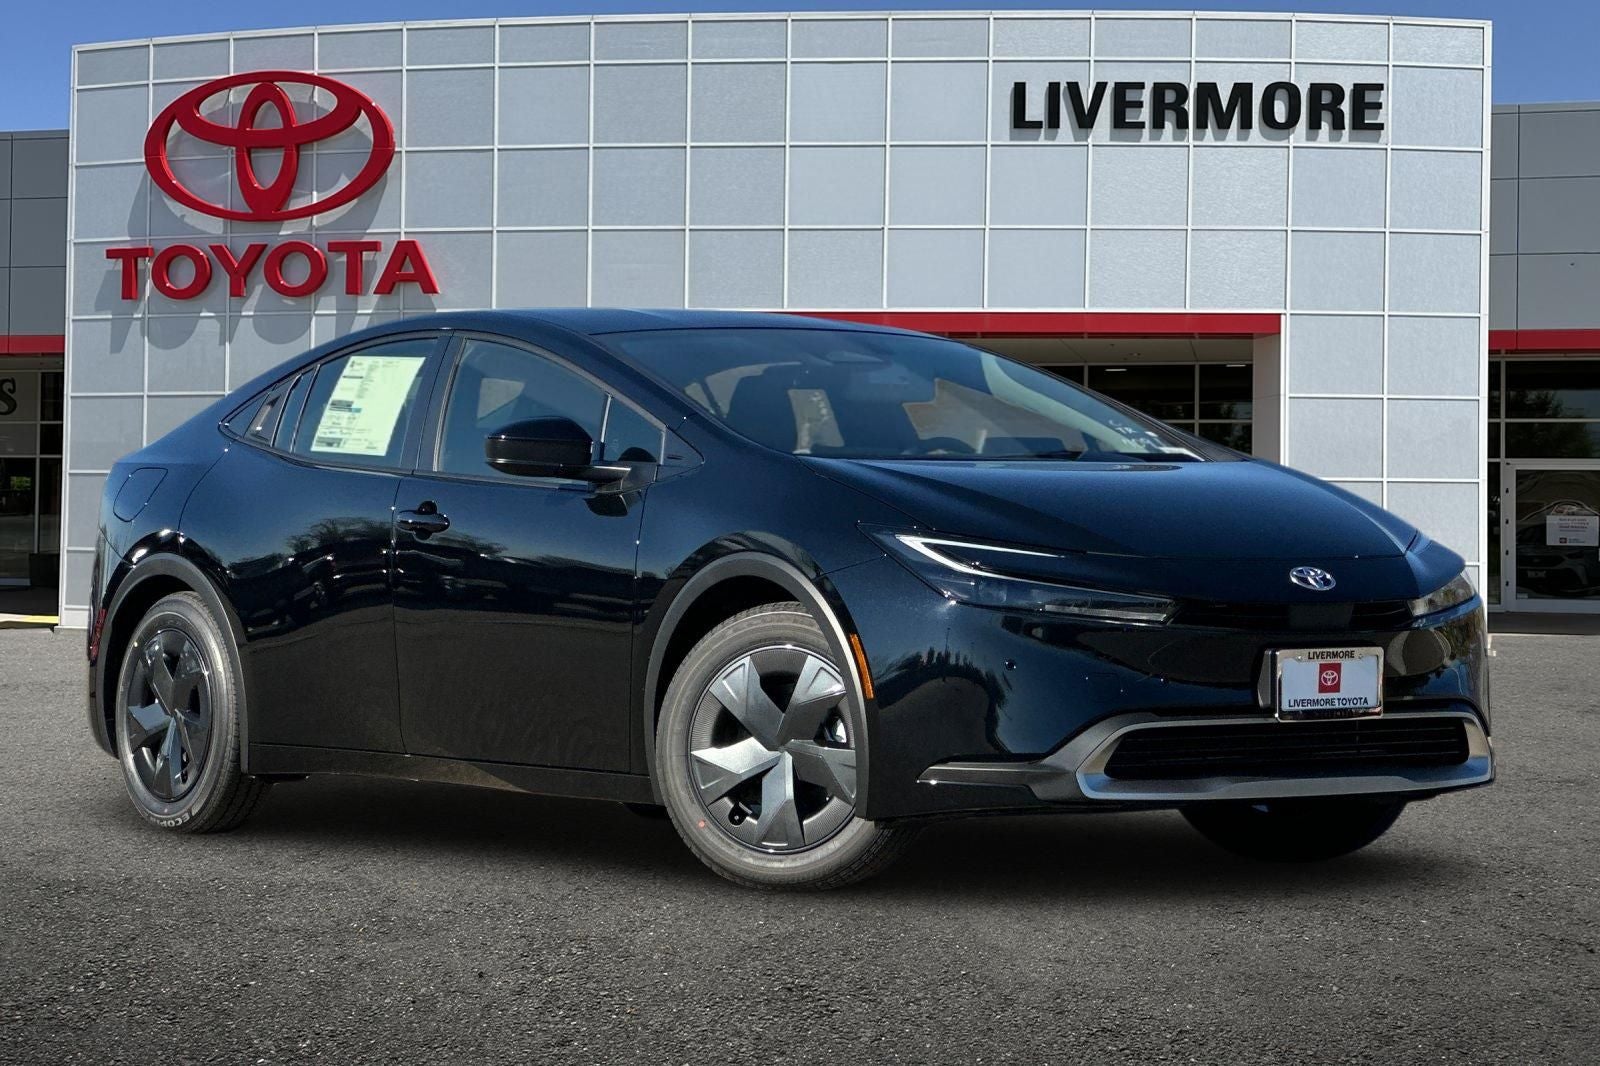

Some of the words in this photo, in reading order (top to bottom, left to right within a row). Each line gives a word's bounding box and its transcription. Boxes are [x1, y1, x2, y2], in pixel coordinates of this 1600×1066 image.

[1012, 81, 1385, 131] LIVERMORE
[105, 239, 440, 300] TOYOTA
[1308, 650, 1355, 660] LIVERMORE
[1288, 698, 1336, 708] LIVERMORE
[1337, 697, 1369, 707] TOYOTA
